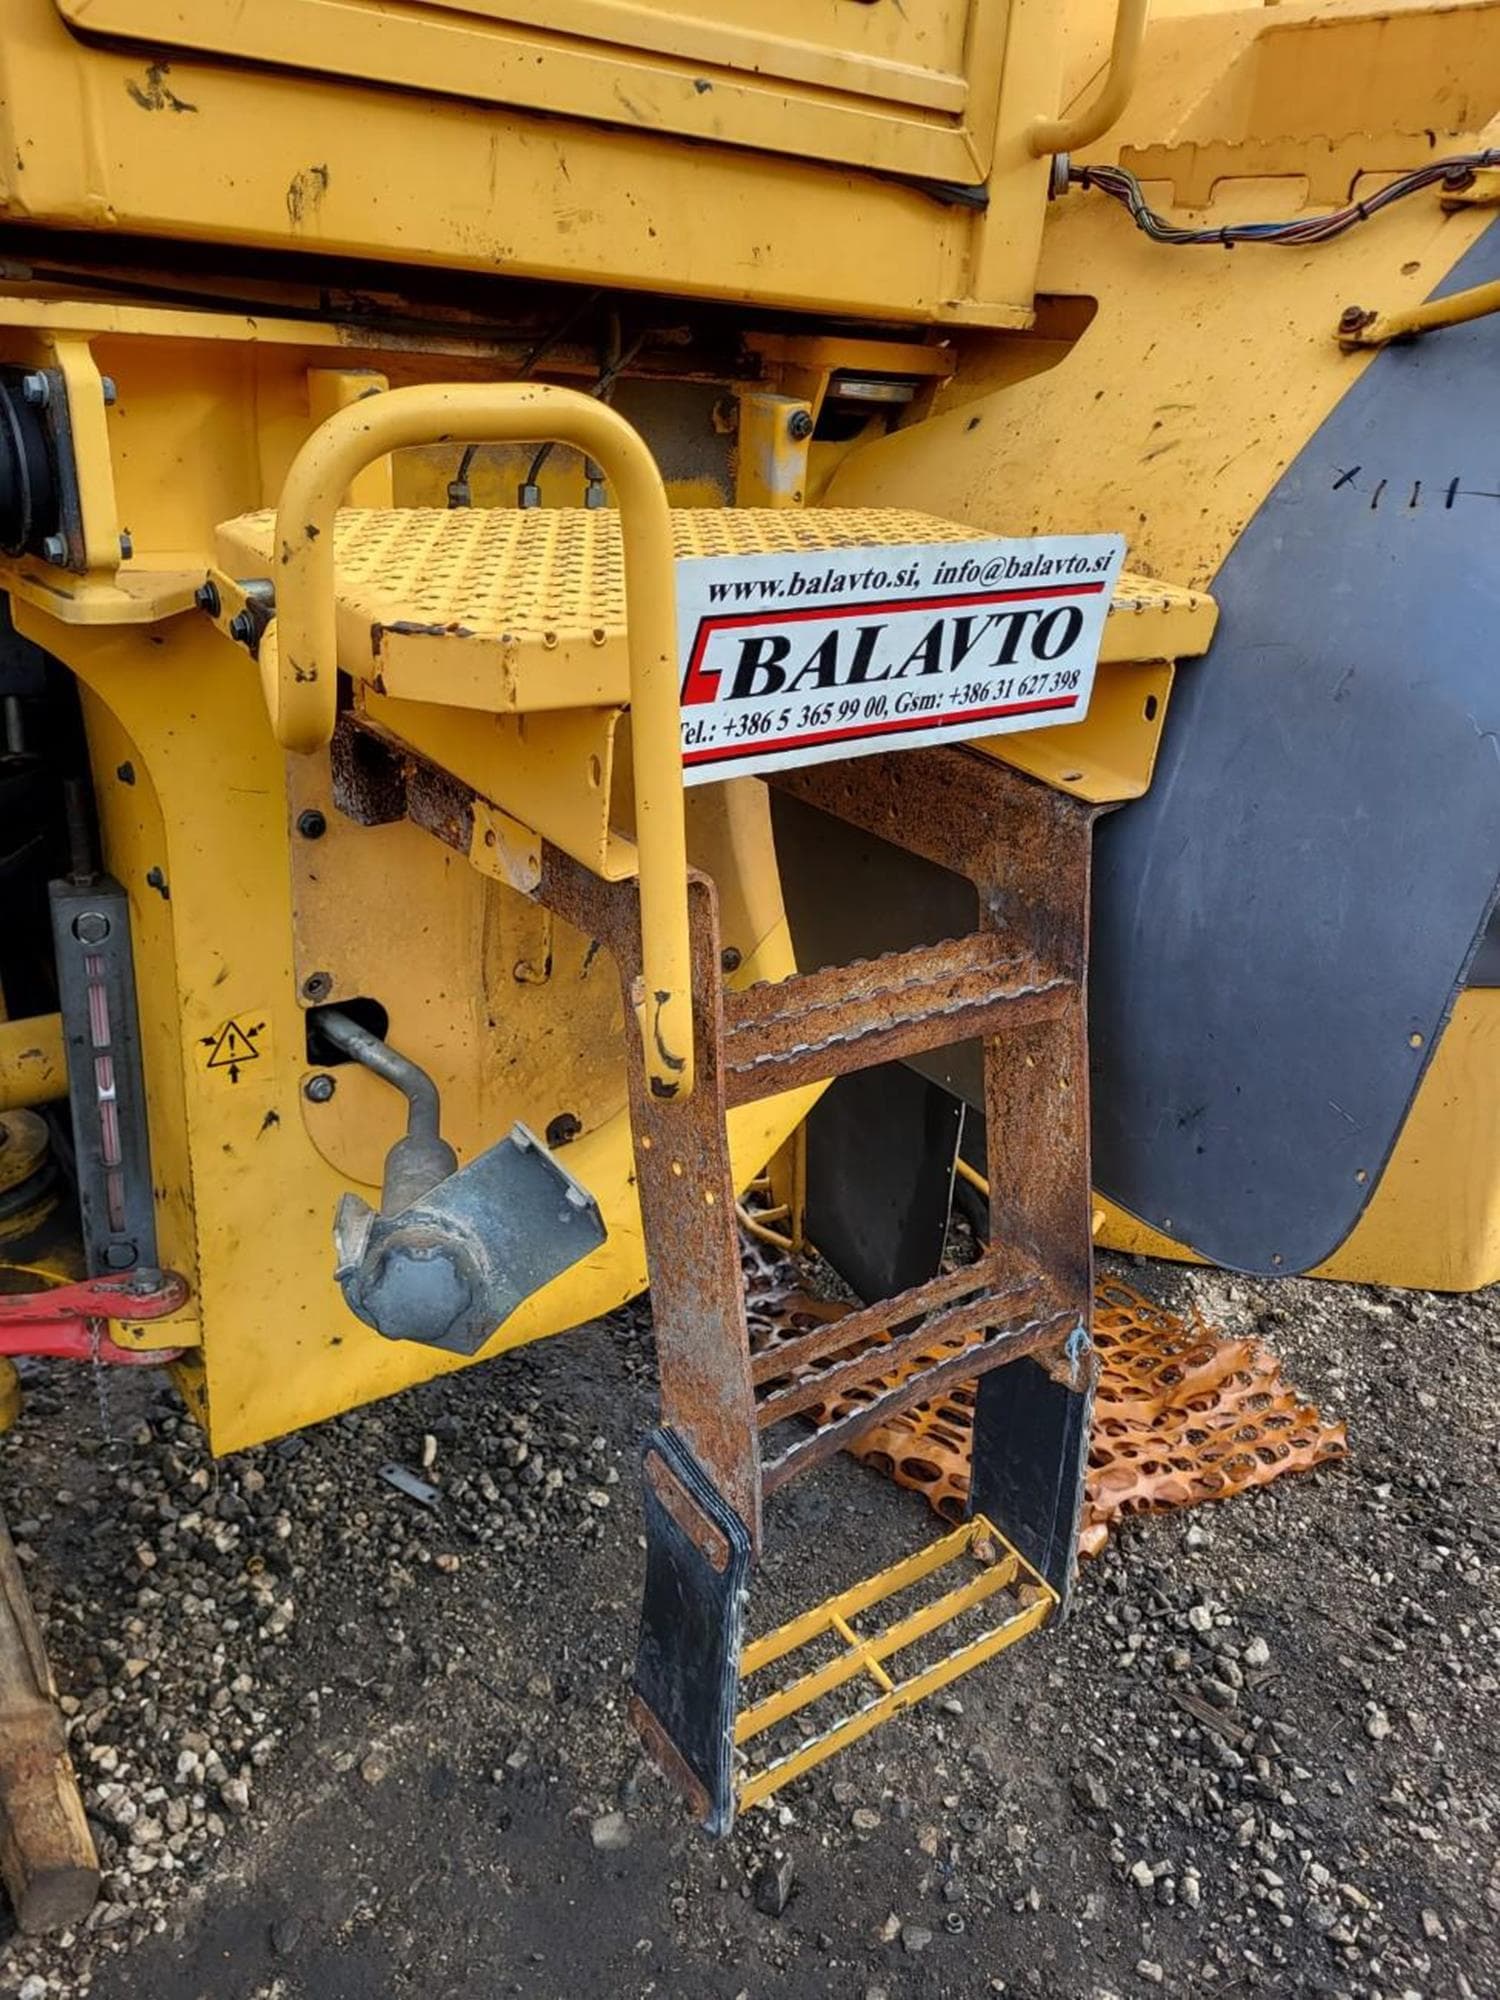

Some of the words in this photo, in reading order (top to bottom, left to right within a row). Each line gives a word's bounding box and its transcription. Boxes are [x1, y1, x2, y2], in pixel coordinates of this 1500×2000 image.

[709, 563, 920, 603] www.balavto.si,
[932, 550, 1115, 587] info@balavto.si
[724, 605, 1083, 701] BALAVTO
[723, 709, 774, 738] +386
[776, 708, 792, 731] 5
[797, 702, 835, 728] 365
[838, 698, 861, 722] 99
[864, 695, 889, 719] 00,
[895, 690, 944, 713] Gsm:
[949, 681, 990, 705] +386
[993, 678, 1015, 700] 31
[1017, 673, 1049, 696] 627
[1049, 669, 1081, 693] 398
